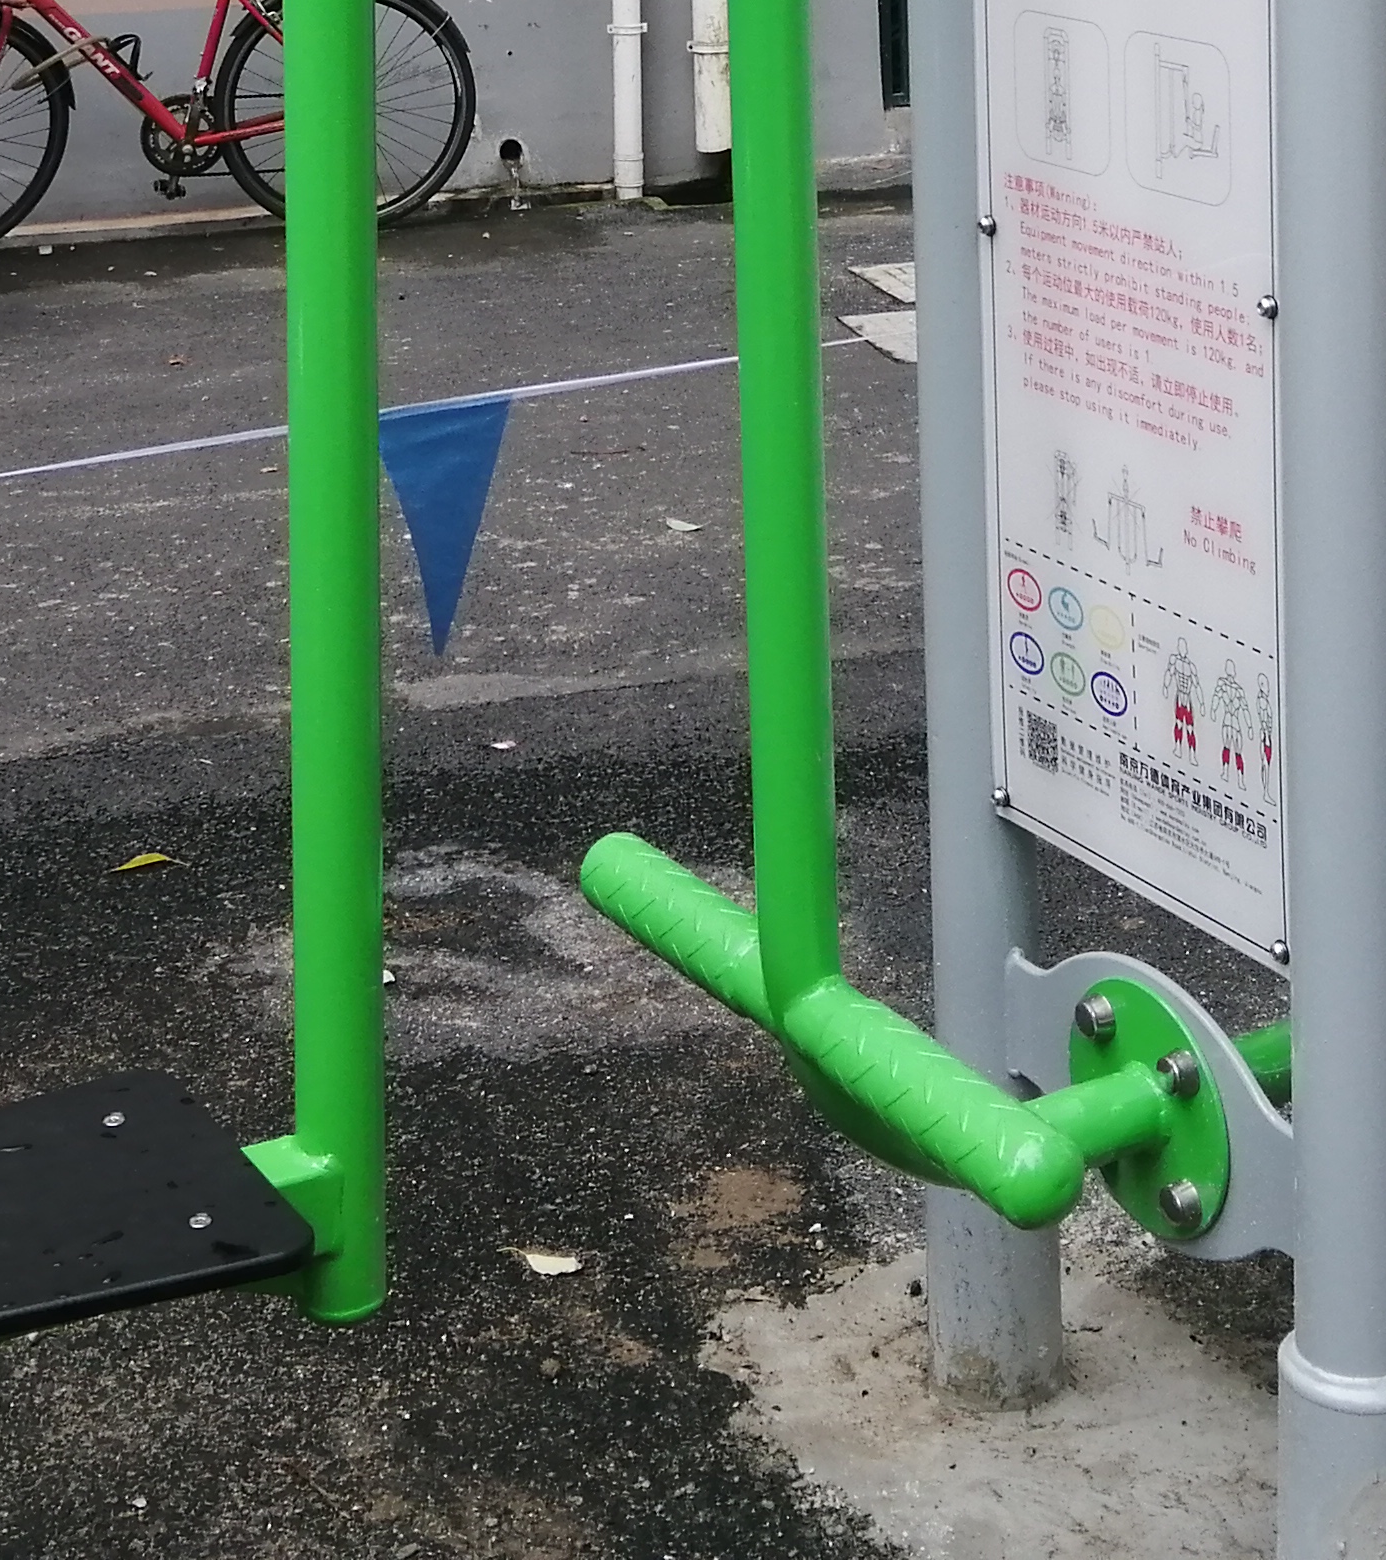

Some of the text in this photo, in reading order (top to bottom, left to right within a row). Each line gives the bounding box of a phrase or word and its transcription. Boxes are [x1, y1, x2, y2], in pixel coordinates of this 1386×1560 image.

[63, 26, 121, 74] GANT
[1019, 220, 1067, 248] Equipment
[1071, 239, 1115, 262] movement
[1119, 251, 1172, 278] direction
[1176, 270, 1215, 291] within
[1020, 245, 1052, 265] meters
[1056, 257, 1100, 282] strictly
[1103, 271, 1149, 295] prohibit
[1154, 286, 1203, 314] standing
[1021, 285, 1038, 304] The
[1041, 296, 1080, 317] maximum
[1084, 306, 1106, 327] load
[1110, 318, 1128, 332] per
[1132, 326, 1180, 351] movement
[1186, 343, 1197, 357] is
[1245, 362, 1265, 379] and
[1022, 310, 1038, 326] the
[1042, 318, 1074, 337] number
[1078, 328, 1090, 342] of
[1094, 336, 1123, 355] users
[1128, 343, 1140, 361] is
[1022, 376, 1055, 397] please
[1059, 389, 1082, 407] stop
[1085, 400, 1114, 422] using
[1119, 411, 1130, 425] it
[1023, 351, 1034, 366] If
[1038, 358, 1065, 379] there
[1070, 372, 1081, 385] is
[1085, 376, 1102, 394] any
[1106, 382, 1164, 415] discomfort
[1167, 403, 1205, 432] during
[1190, 505, 1242, 544] 禁止攀爬
[1183, 528, 1256, 576] No Climbing
